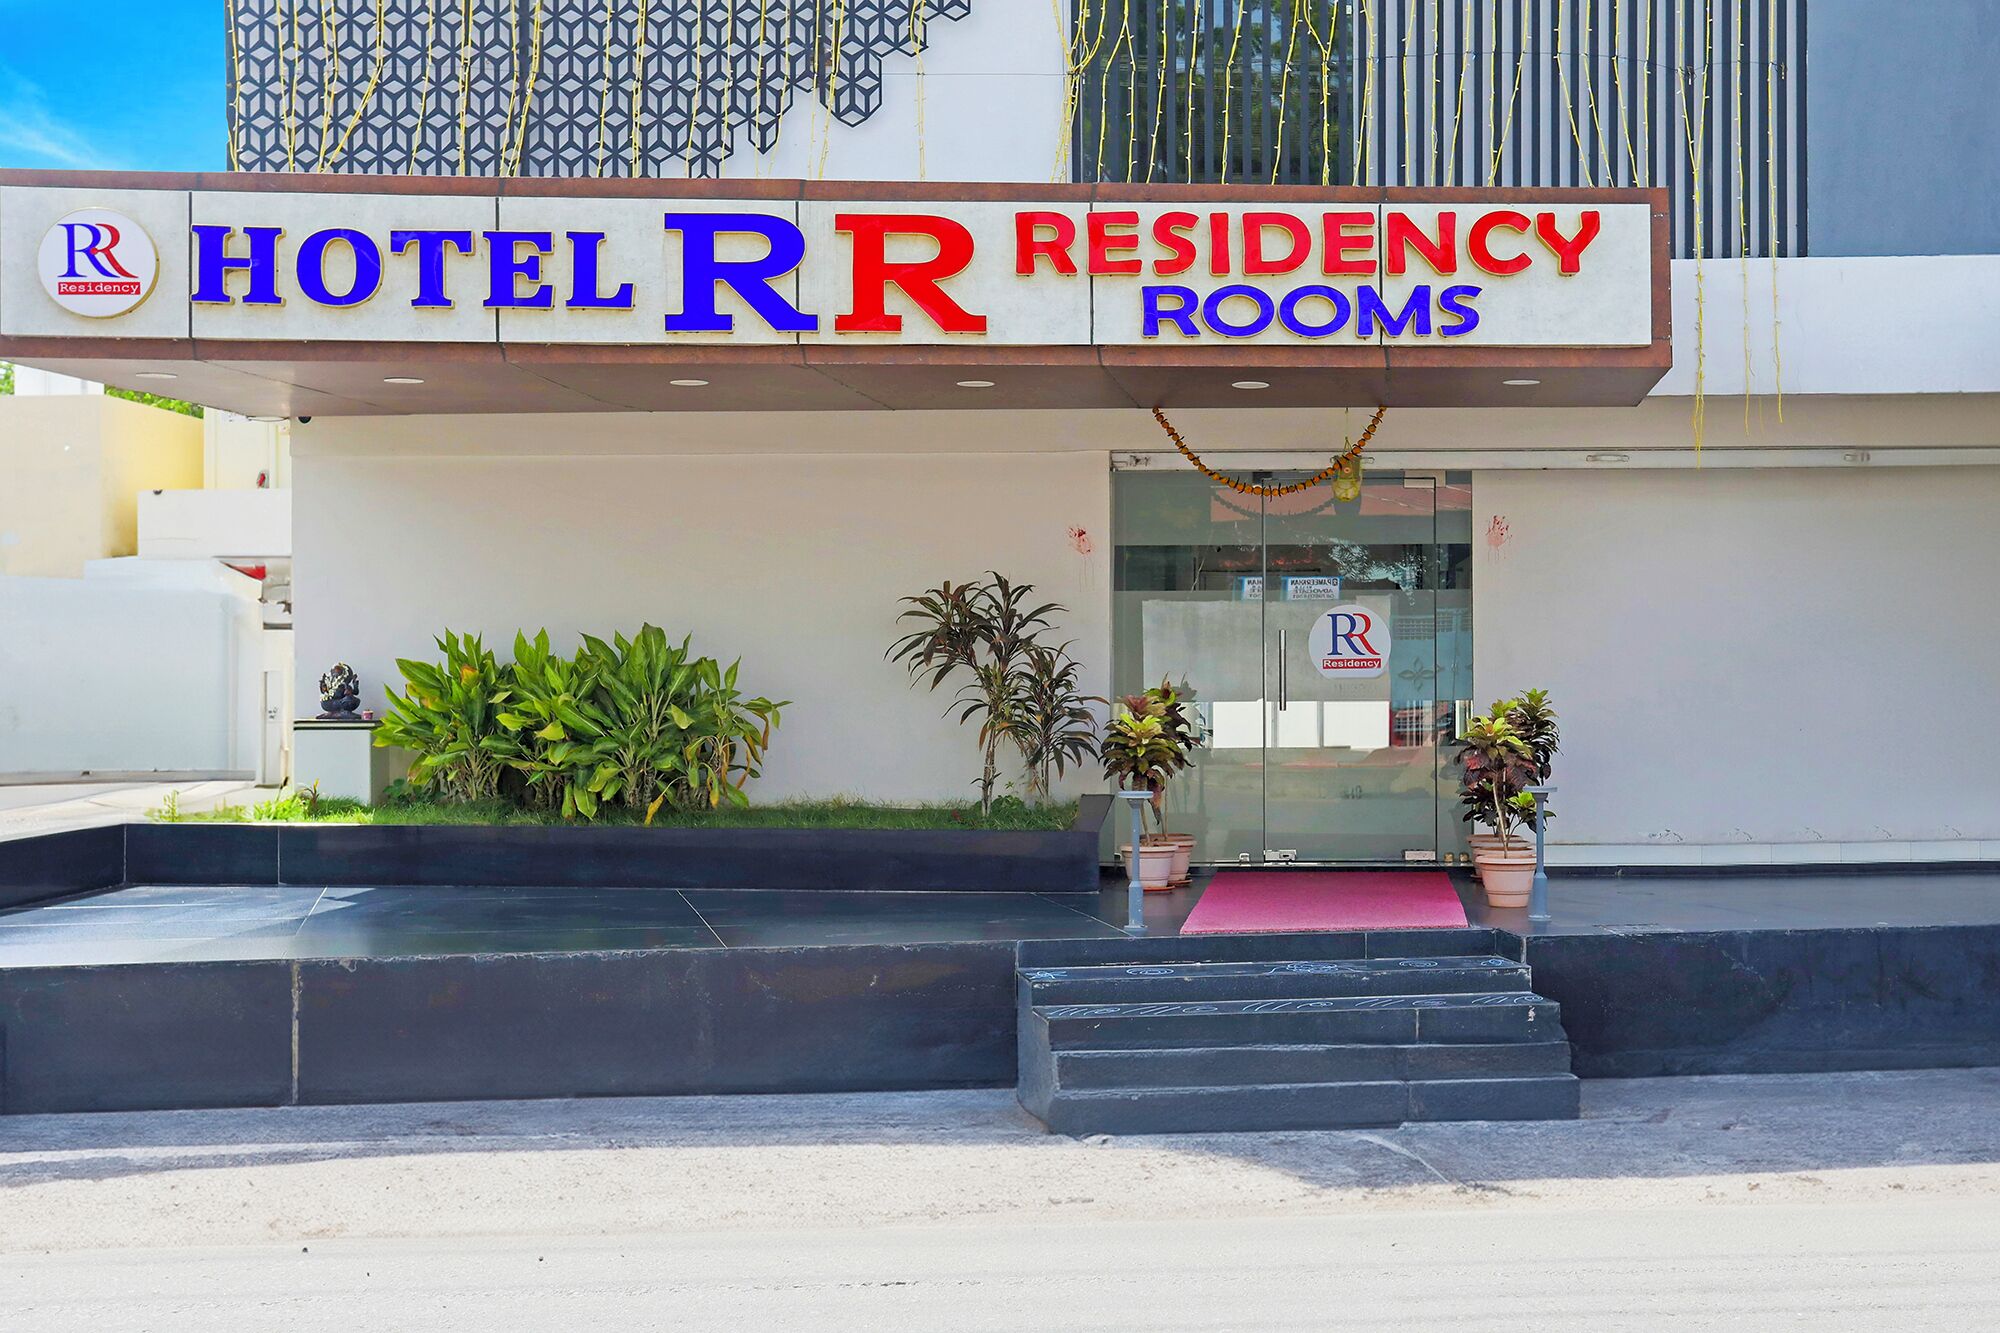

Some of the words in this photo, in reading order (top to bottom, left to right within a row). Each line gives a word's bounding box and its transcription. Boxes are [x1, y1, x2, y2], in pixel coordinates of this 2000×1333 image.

[189, 223, 637, 309] HOTEL
[664, 212, 988, 334] RR
[1014, 210, 1601, 277] RESIDENCY
[60, 283, 139, 294] Residency
[1140, 285, 1484, 339] ROOMS
[1323, 659, 1380, 668] Residency
